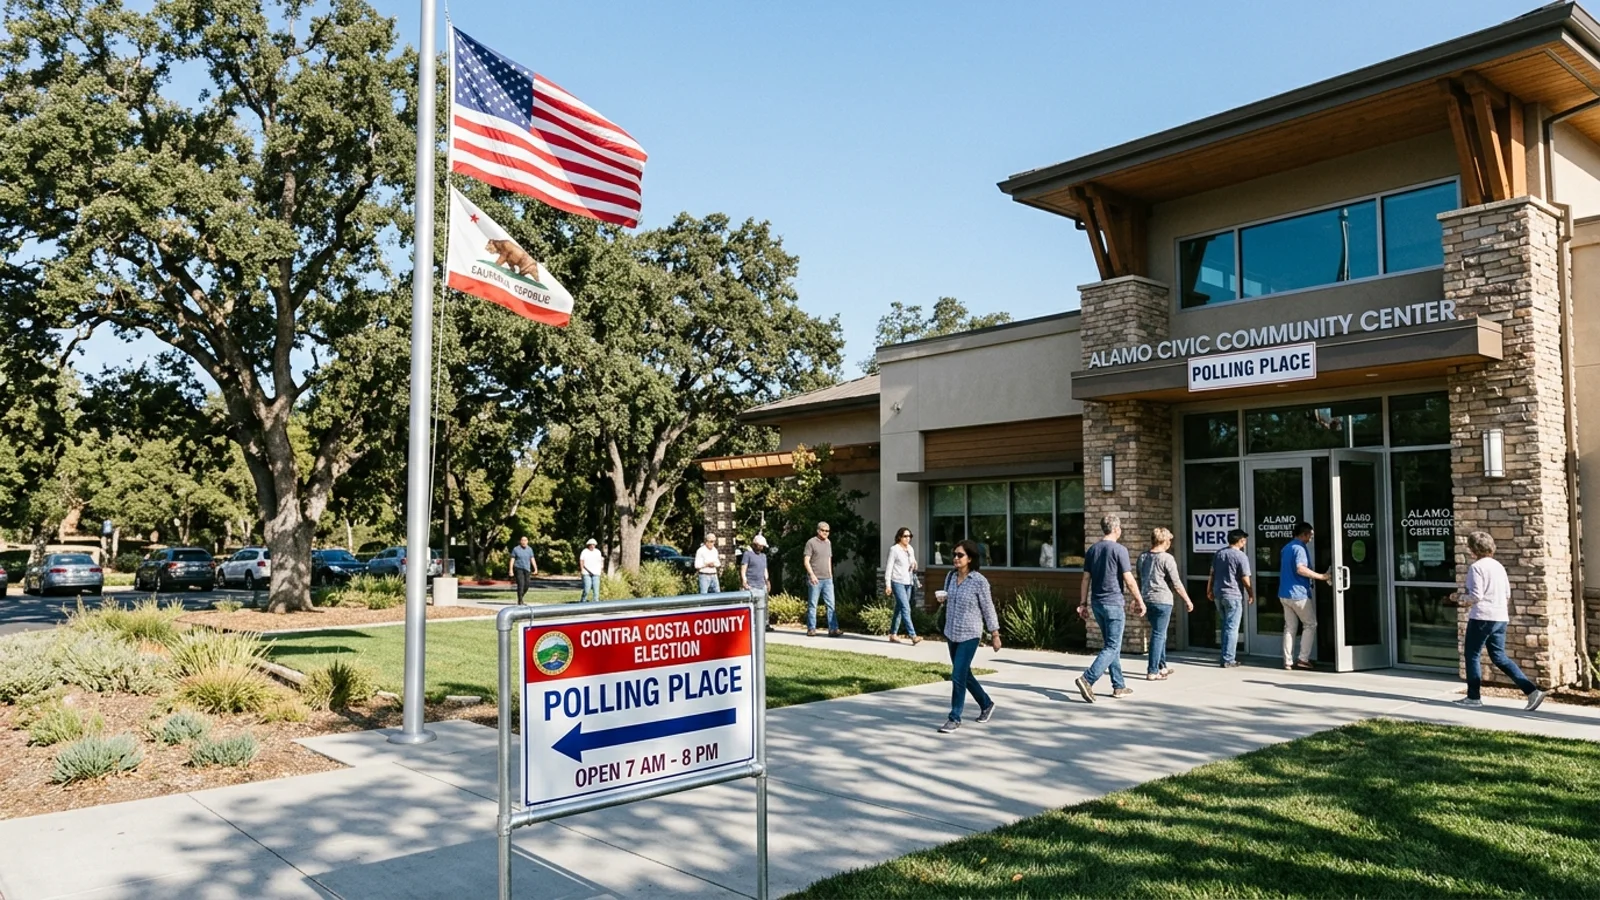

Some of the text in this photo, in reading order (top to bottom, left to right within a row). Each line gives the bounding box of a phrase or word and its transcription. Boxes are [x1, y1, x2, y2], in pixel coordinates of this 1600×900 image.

[1088, 300, 1456, 369] ALAMO CIVIC COMMUNITY CENTER
[1192, 353, 1310, 382] POLLING PLACE
[1194, 513, 1236, 528] VOTE
[1194, 531, 1228, 545] HER
[580, 615, 745, 648] CONTRA COSTA COUNTY
[634, 640, 700, 664] ELECTION
[544, 665, 743, 721] POLLING PLACE
[575, 762, 620, 788] OPEN
[626, 759, 635, 777] 7
[640, 753, 666, 775] AM
[682, 749, 691, 766] 8
[696, 742, 718, 763] PM
